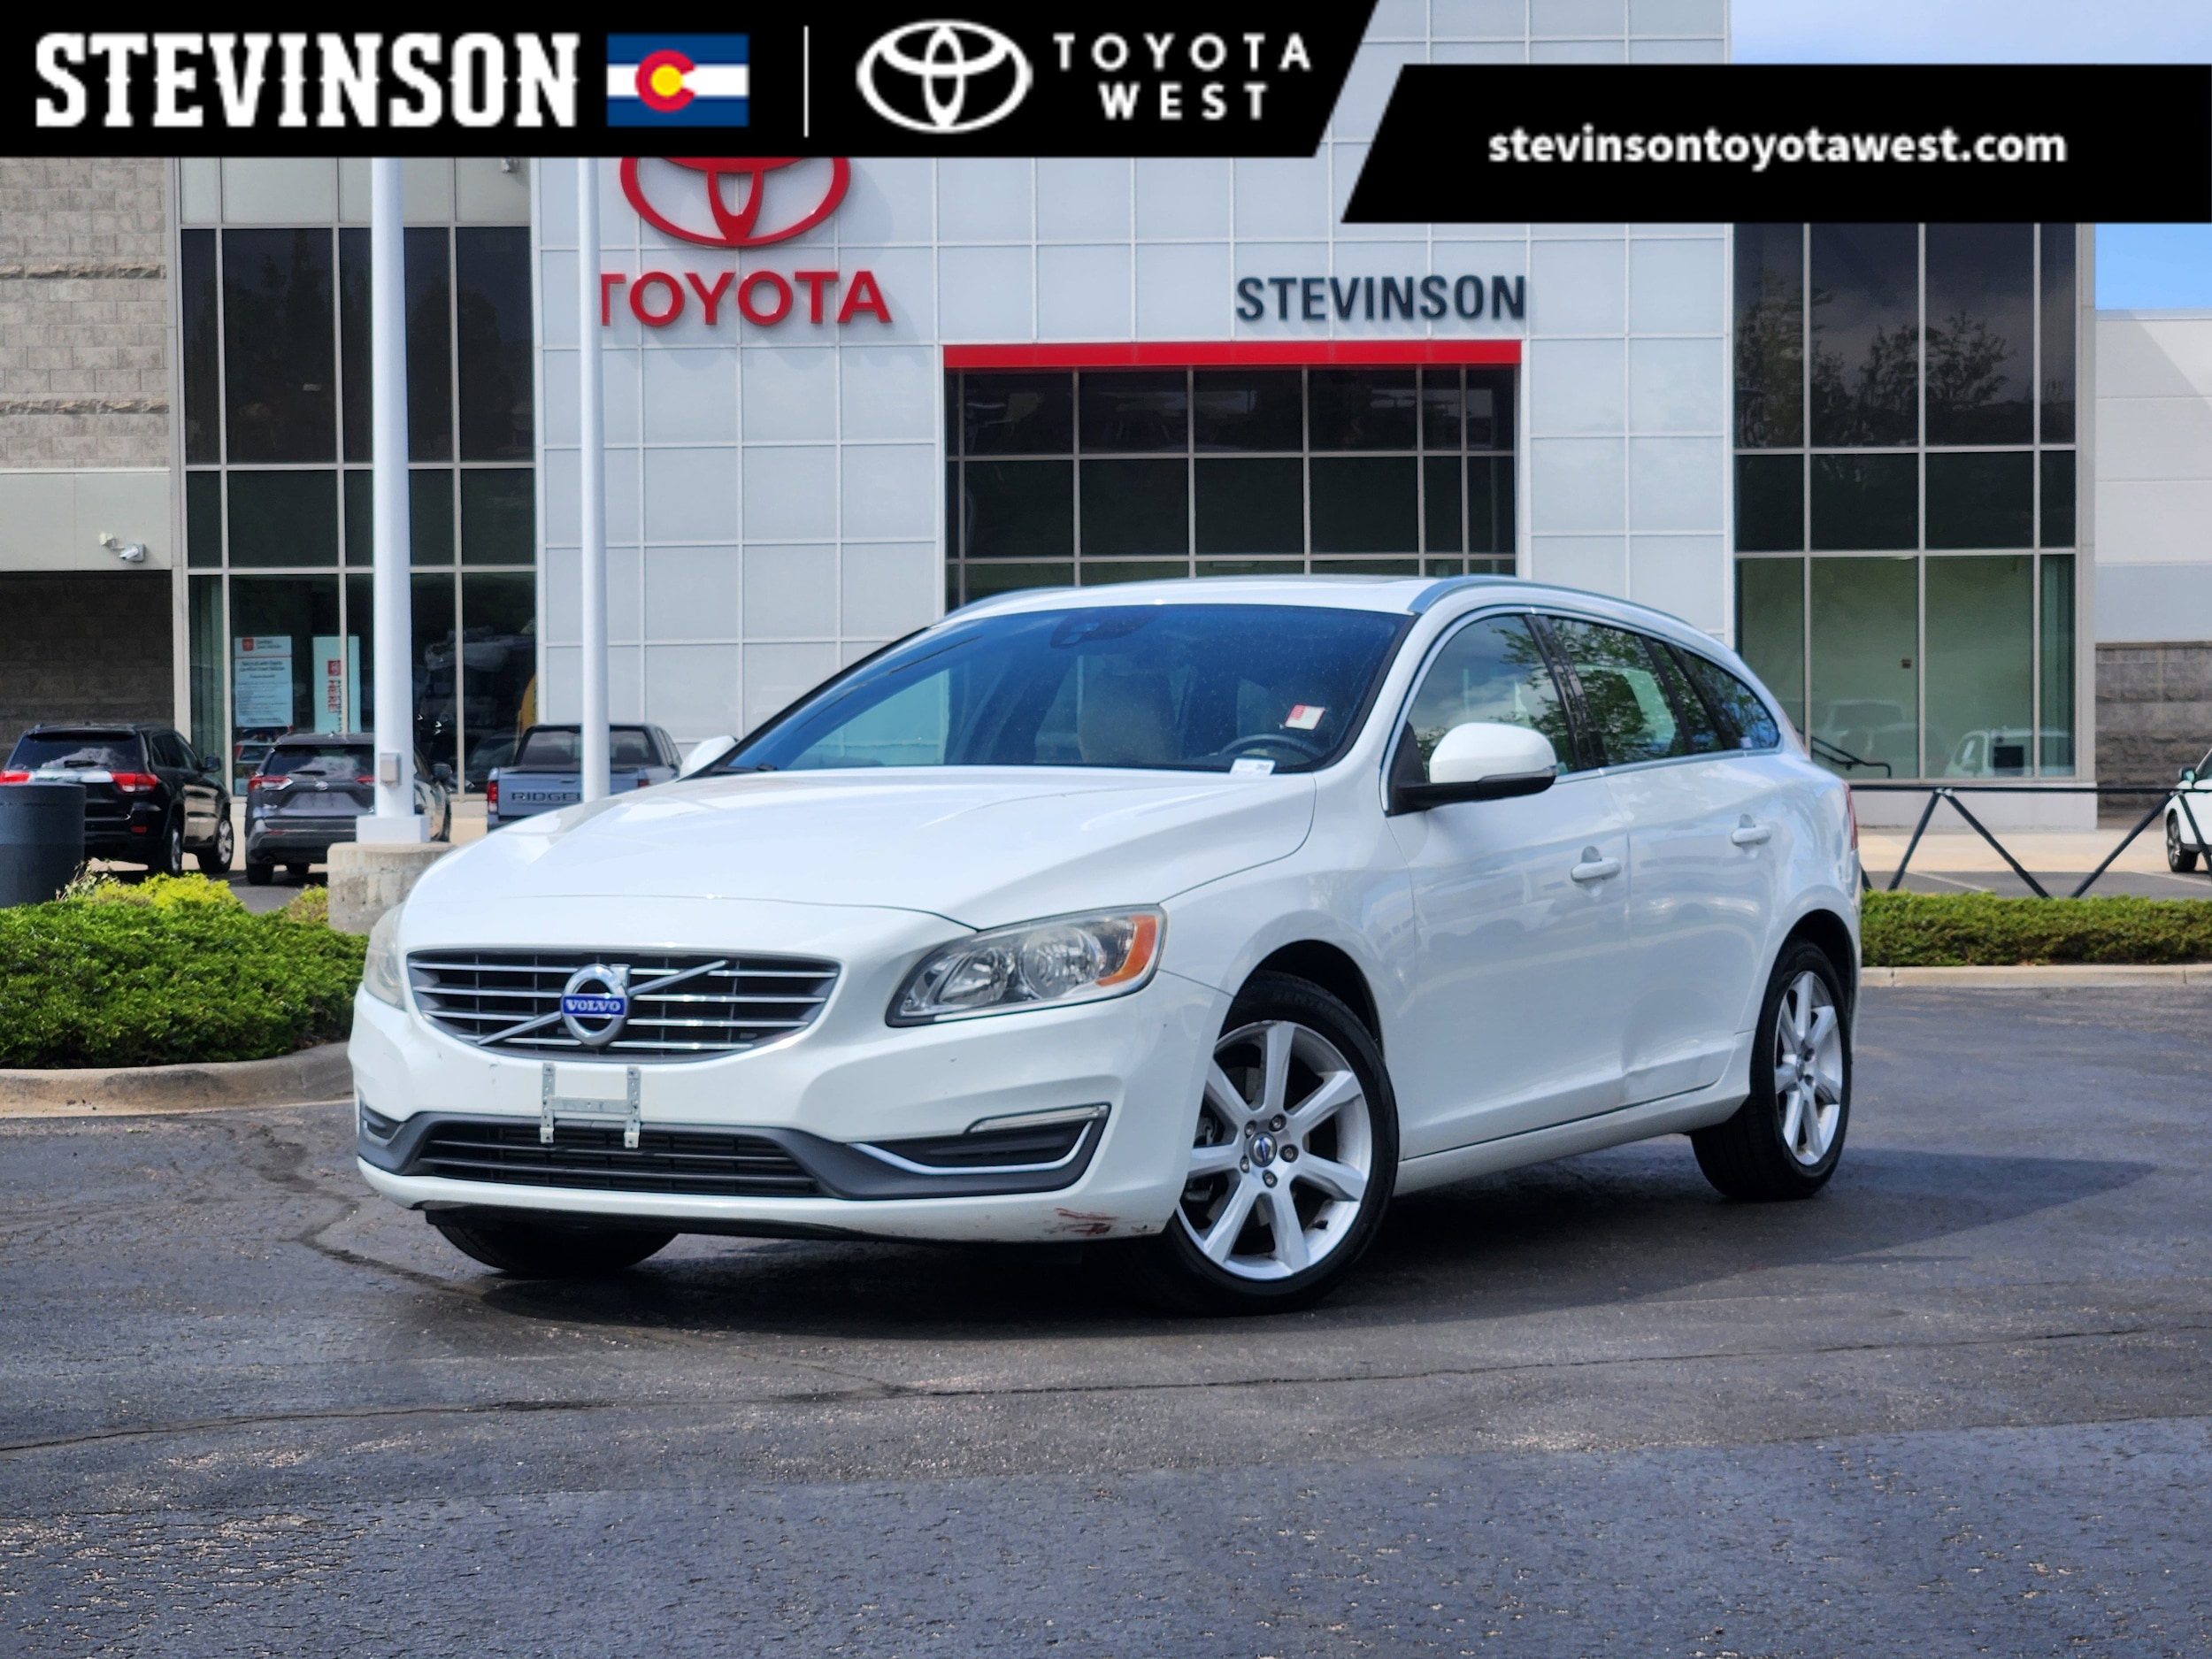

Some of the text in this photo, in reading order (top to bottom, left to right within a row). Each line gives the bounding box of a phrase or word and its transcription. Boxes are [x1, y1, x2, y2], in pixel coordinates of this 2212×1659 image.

[601, 270, 892, 326] TOYOTA
[1236, 275, 1525, 321] STEVINSON
[565, 998, 622, 1012] VOLVO
